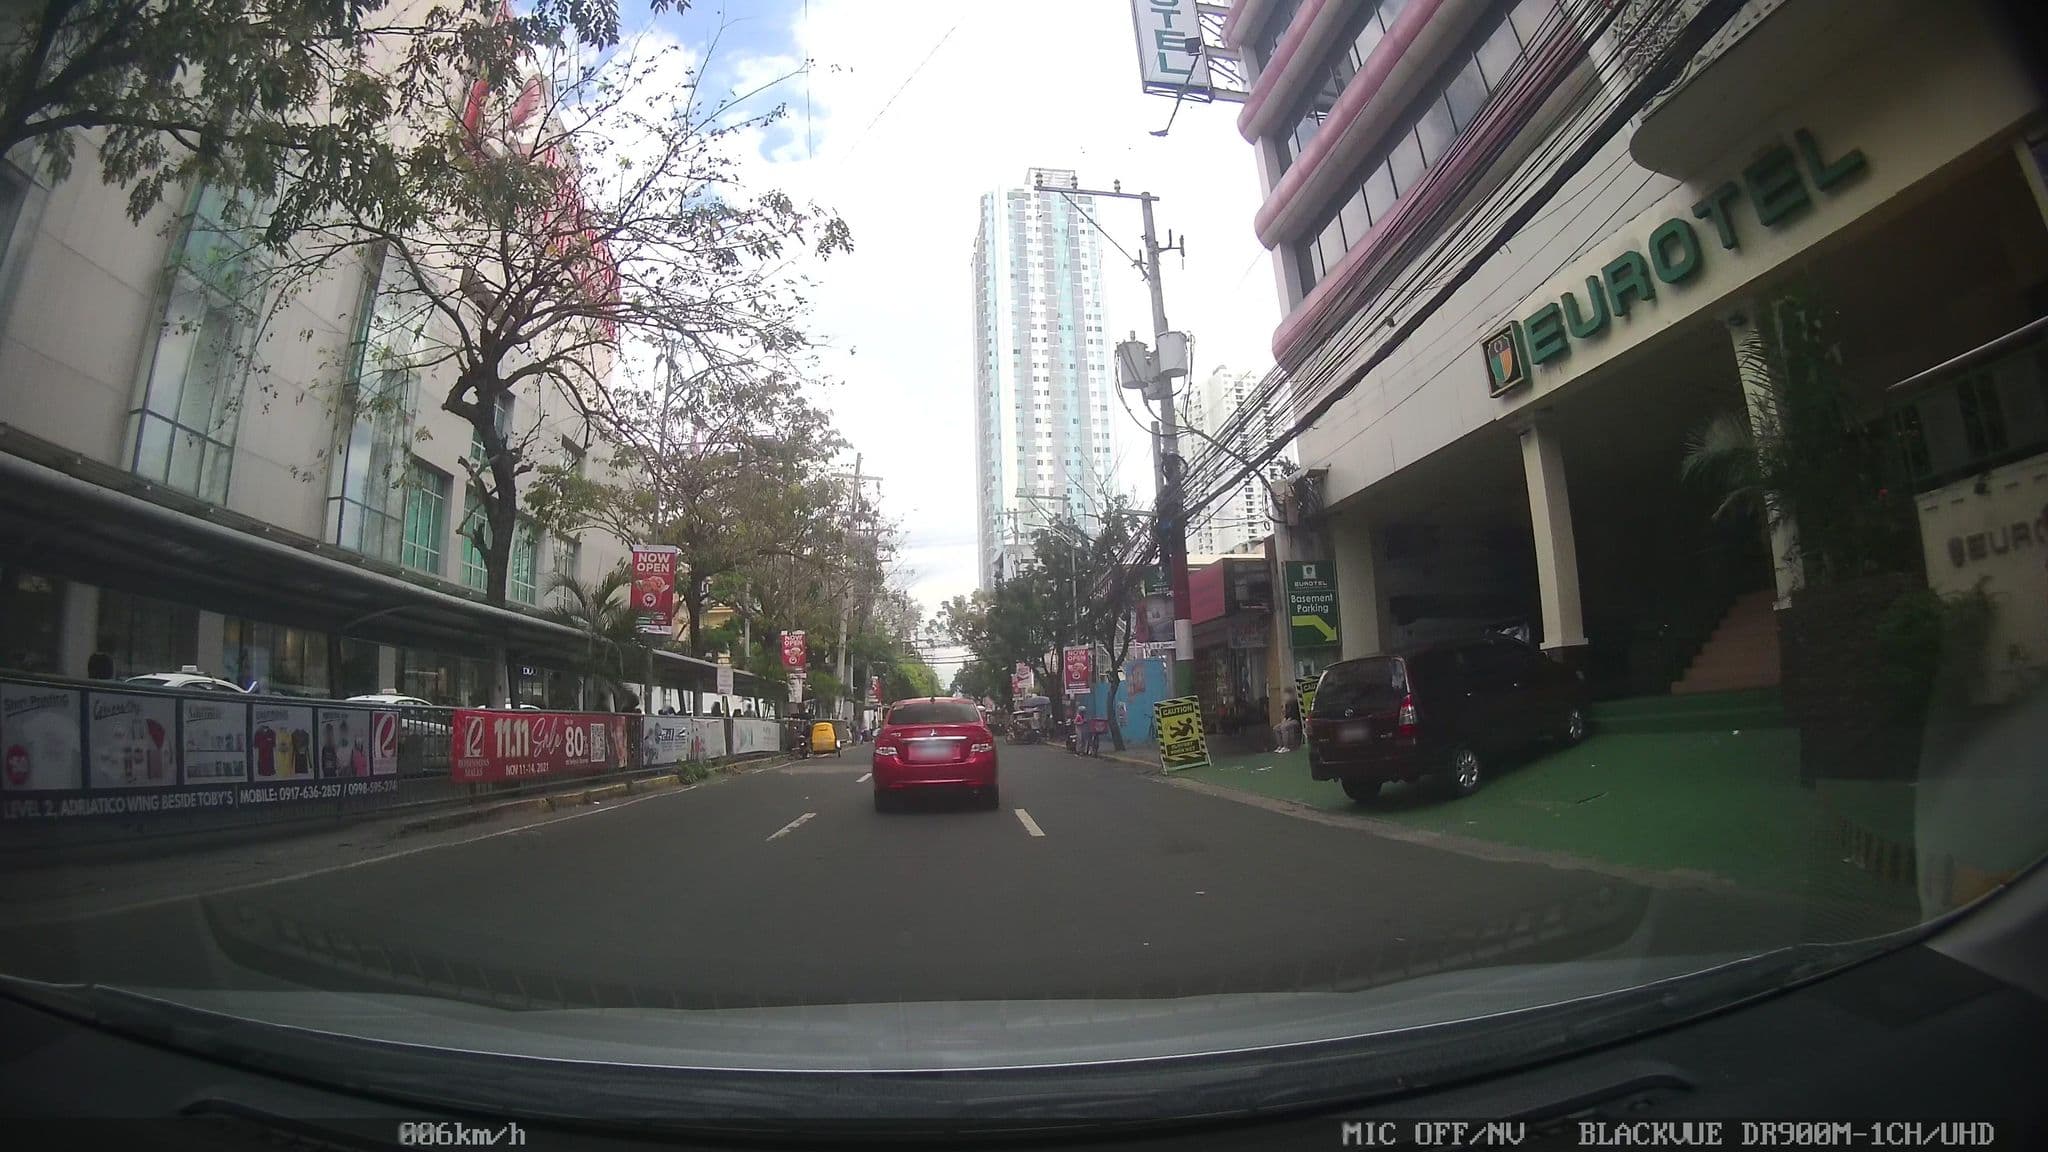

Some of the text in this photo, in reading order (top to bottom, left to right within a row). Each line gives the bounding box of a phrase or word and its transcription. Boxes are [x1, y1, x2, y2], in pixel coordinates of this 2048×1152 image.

[1524, 125, 1868, 366] EUROTEL
[638, 553, 670, 563] NOW
[636, 563, 670, 573] OPEN
[1290, 594, 1333, 604] Basement
[1296, 604, 1329, 614] Parking
[1162, 705, 1194, 718] CAUTION
[494, 717, 529, 758] 11.11
[505, 764, 518, 777] NOV
[536, 762, 549, 774] 2021
[61, 796, 126, 817] ADRIATICO
[127, 794, 160, 813] WING
[162, 793, 198, 809] BESIDE
[197, 791, 233, 806] TOBY'S
[240, 788, 277, 803] MOBILE:
[279, 783, 341, 800] 0917-636-2857
